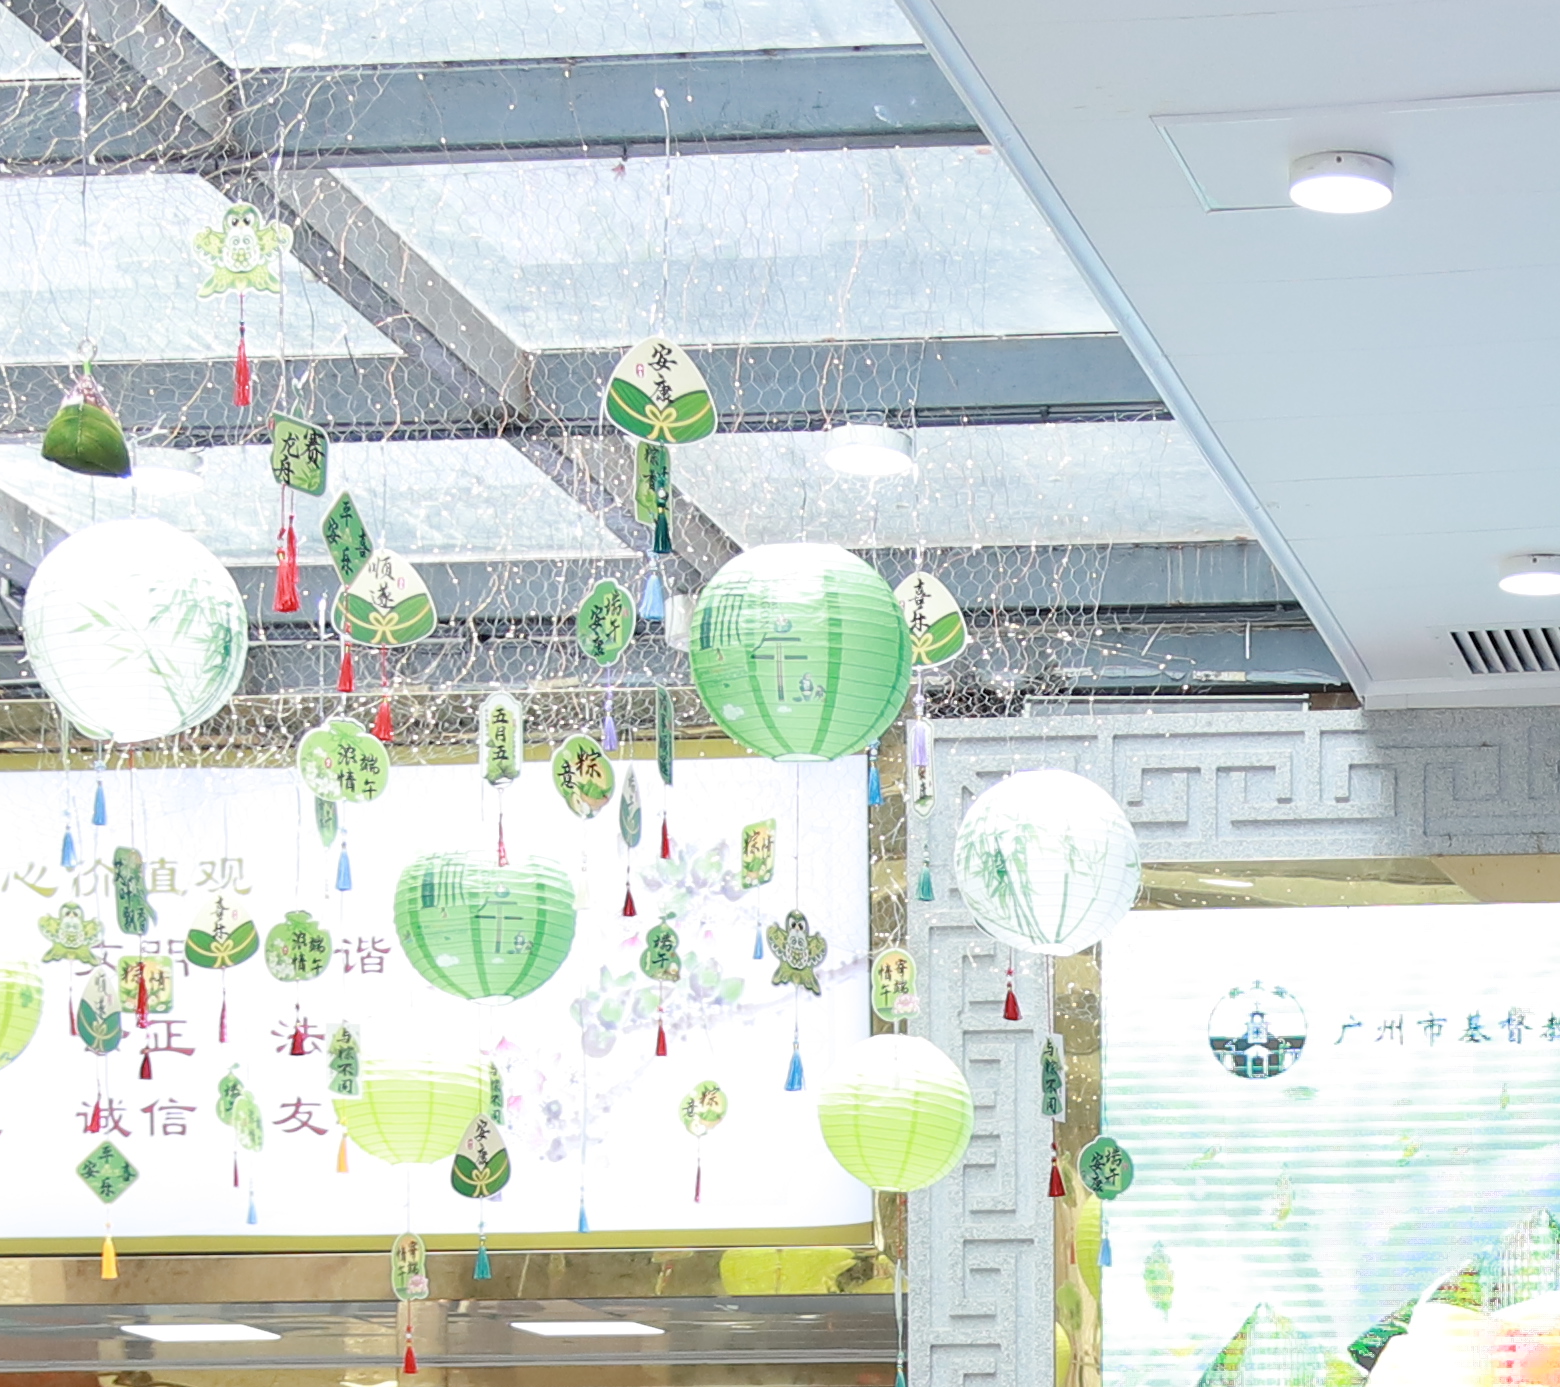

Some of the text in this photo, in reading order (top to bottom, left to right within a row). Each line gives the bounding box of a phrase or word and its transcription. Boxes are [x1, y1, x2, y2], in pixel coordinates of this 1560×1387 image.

[646, 344, 678, 405] 安康
[910, 578, 931, 632] 喜乐
[491, 708, 509, 761] 五月五
[653, 933, 673, 968] 端午
[75, 1098, 197, 1138] 诚信
